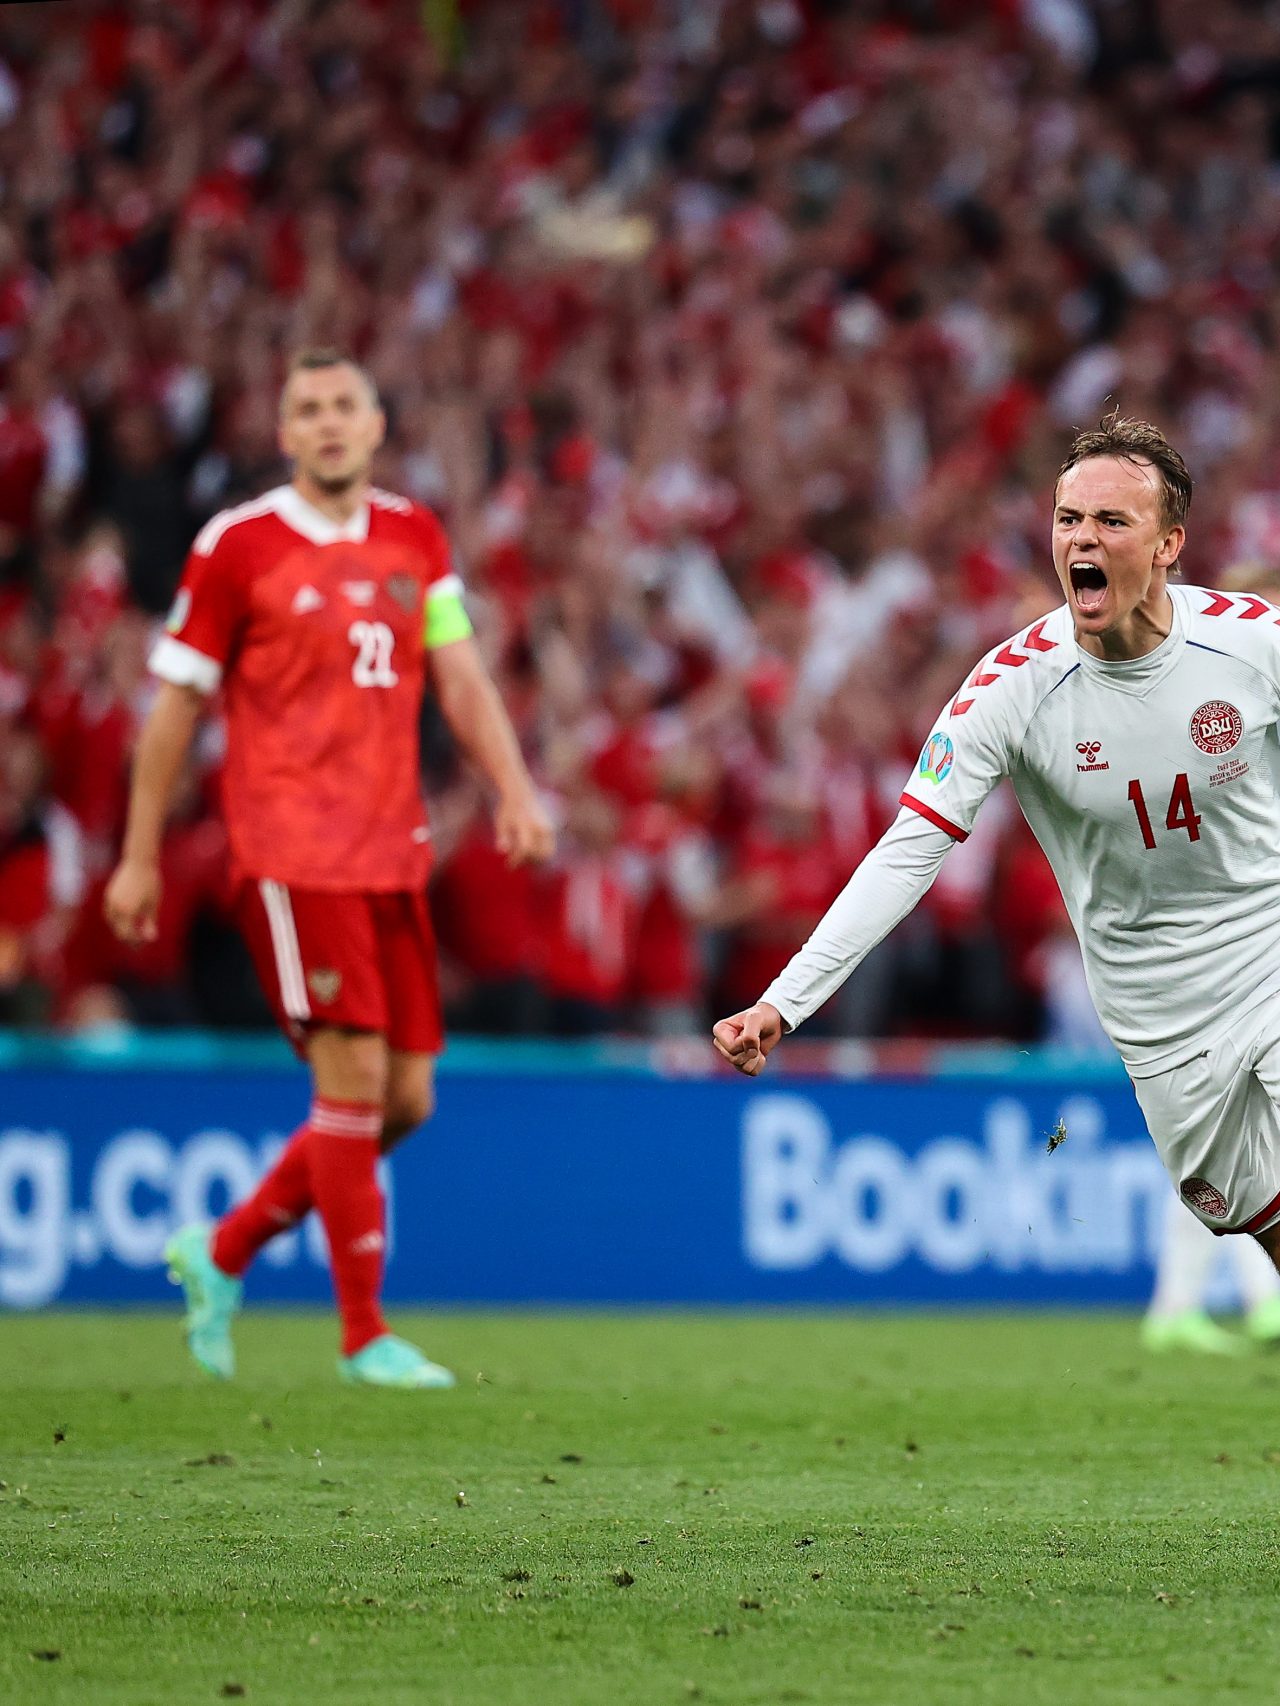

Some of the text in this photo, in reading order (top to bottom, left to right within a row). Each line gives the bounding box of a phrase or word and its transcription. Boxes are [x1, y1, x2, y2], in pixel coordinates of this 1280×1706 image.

[347, 620, 399, 688] 22
[1200, 716, 1232, 739] DBU
[1211, 743, 1232, 754] 1889
[1076, 761, 1109, 772] hummel
[1128, 772, 1201, 850] 14
